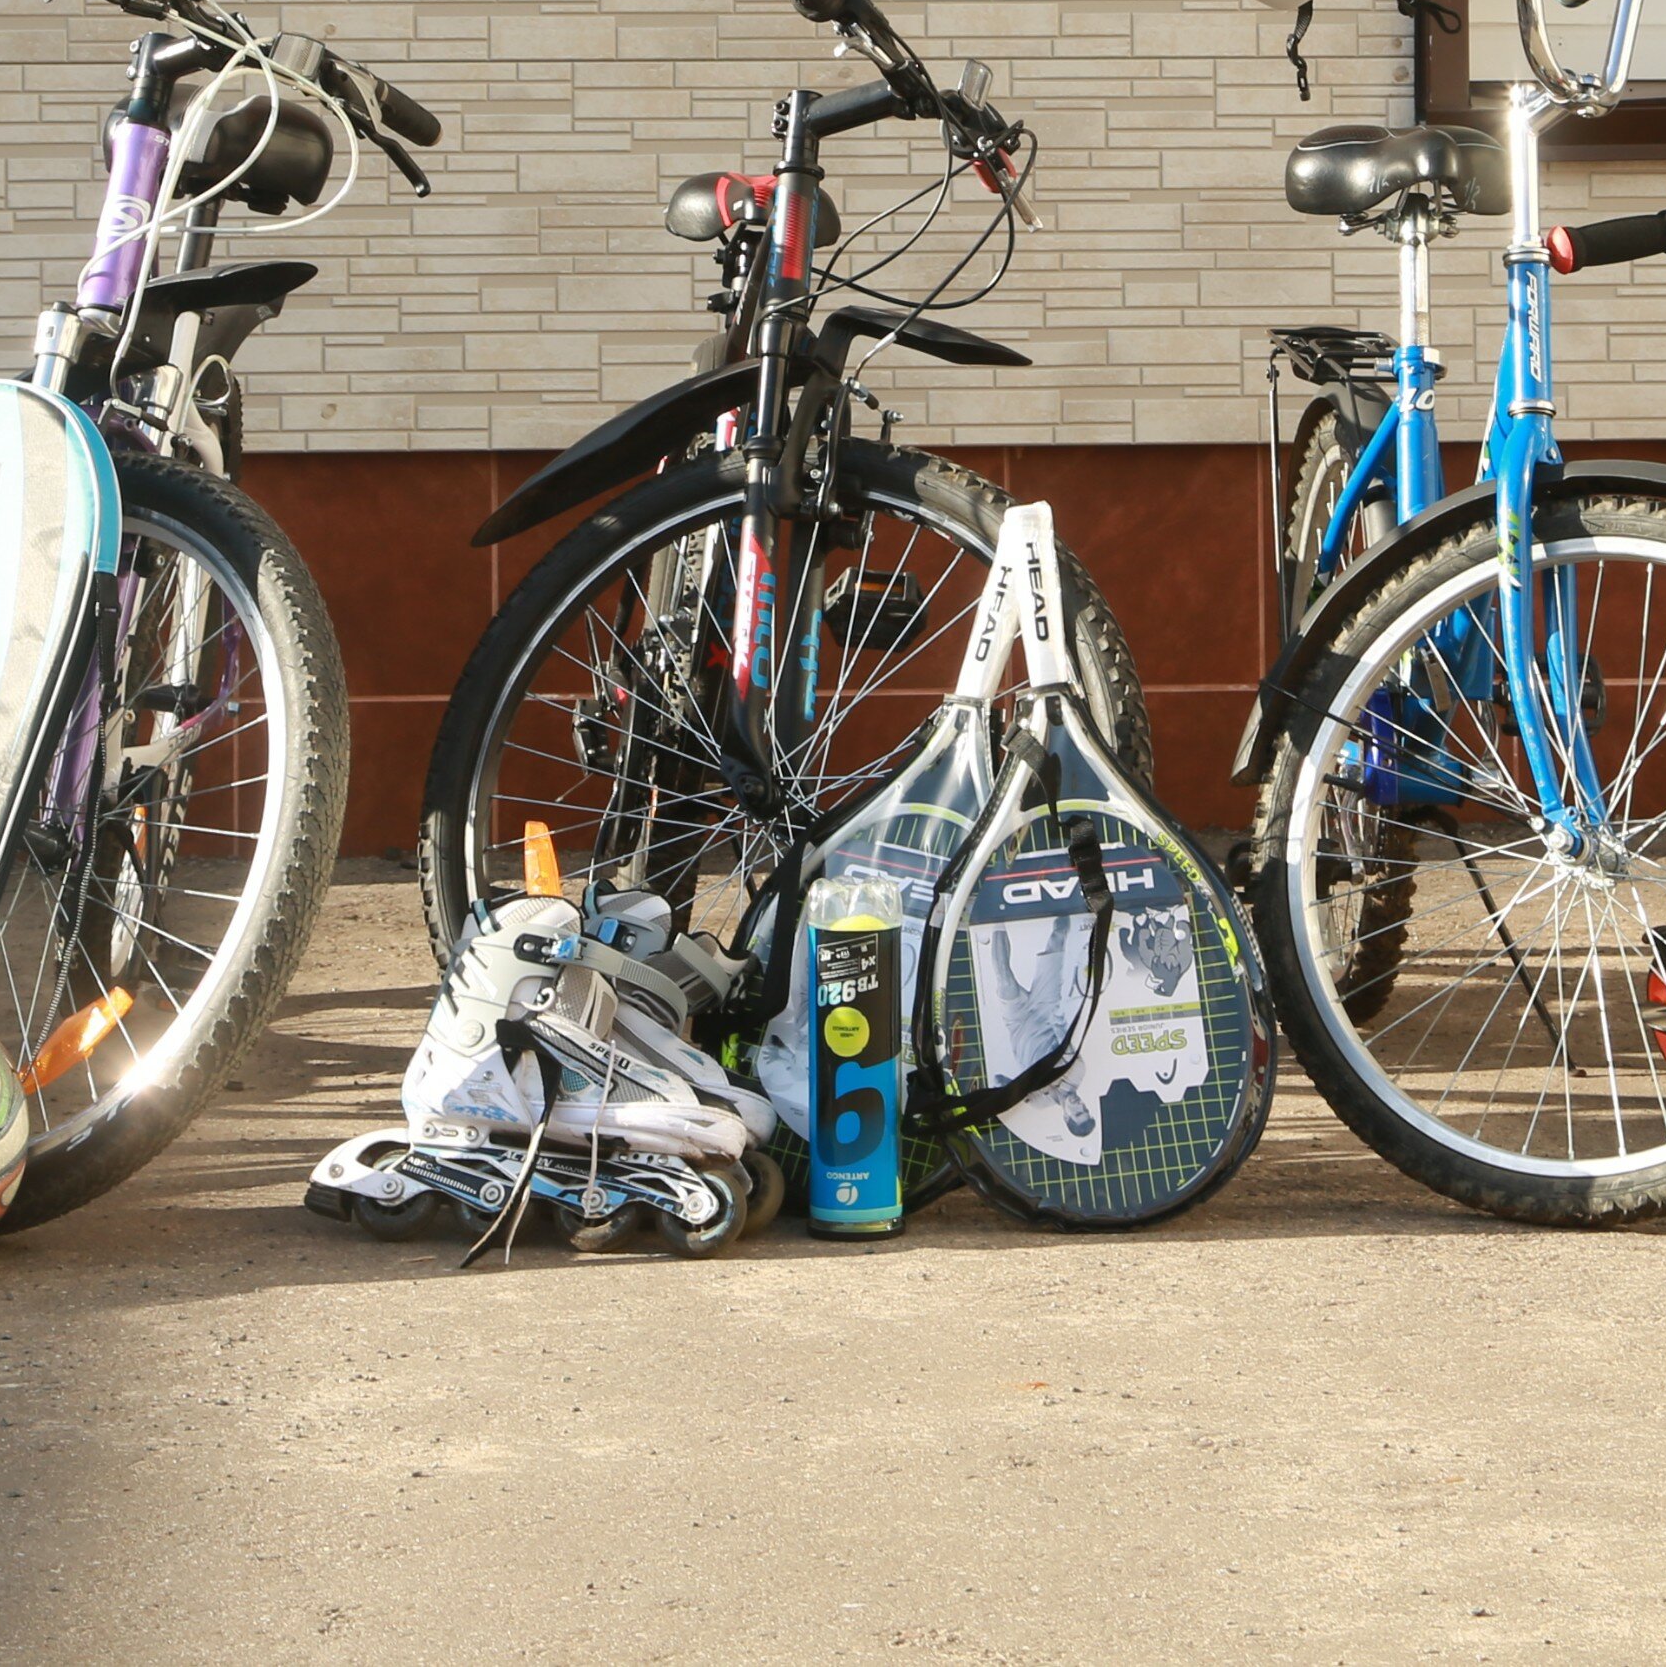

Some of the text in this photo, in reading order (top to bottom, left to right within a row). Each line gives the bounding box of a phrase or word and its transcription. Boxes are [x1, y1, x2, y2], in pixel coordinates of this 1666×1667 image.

[1526, 269, 1542, 384] FORWARD
[974, 565, 1013, 662] HEAD
[1025, 541, 1050, 642] HEAD
[1154, 831, 1203, 884] SPEED
[816, 973, 880, 1008] TB920
[1110, 1022, 1165, 1034] JUNIOR SERIES
[1110, 1027, 1188, 1056] SPEED
[826, 1171, 871, 1181] ARTENGO
